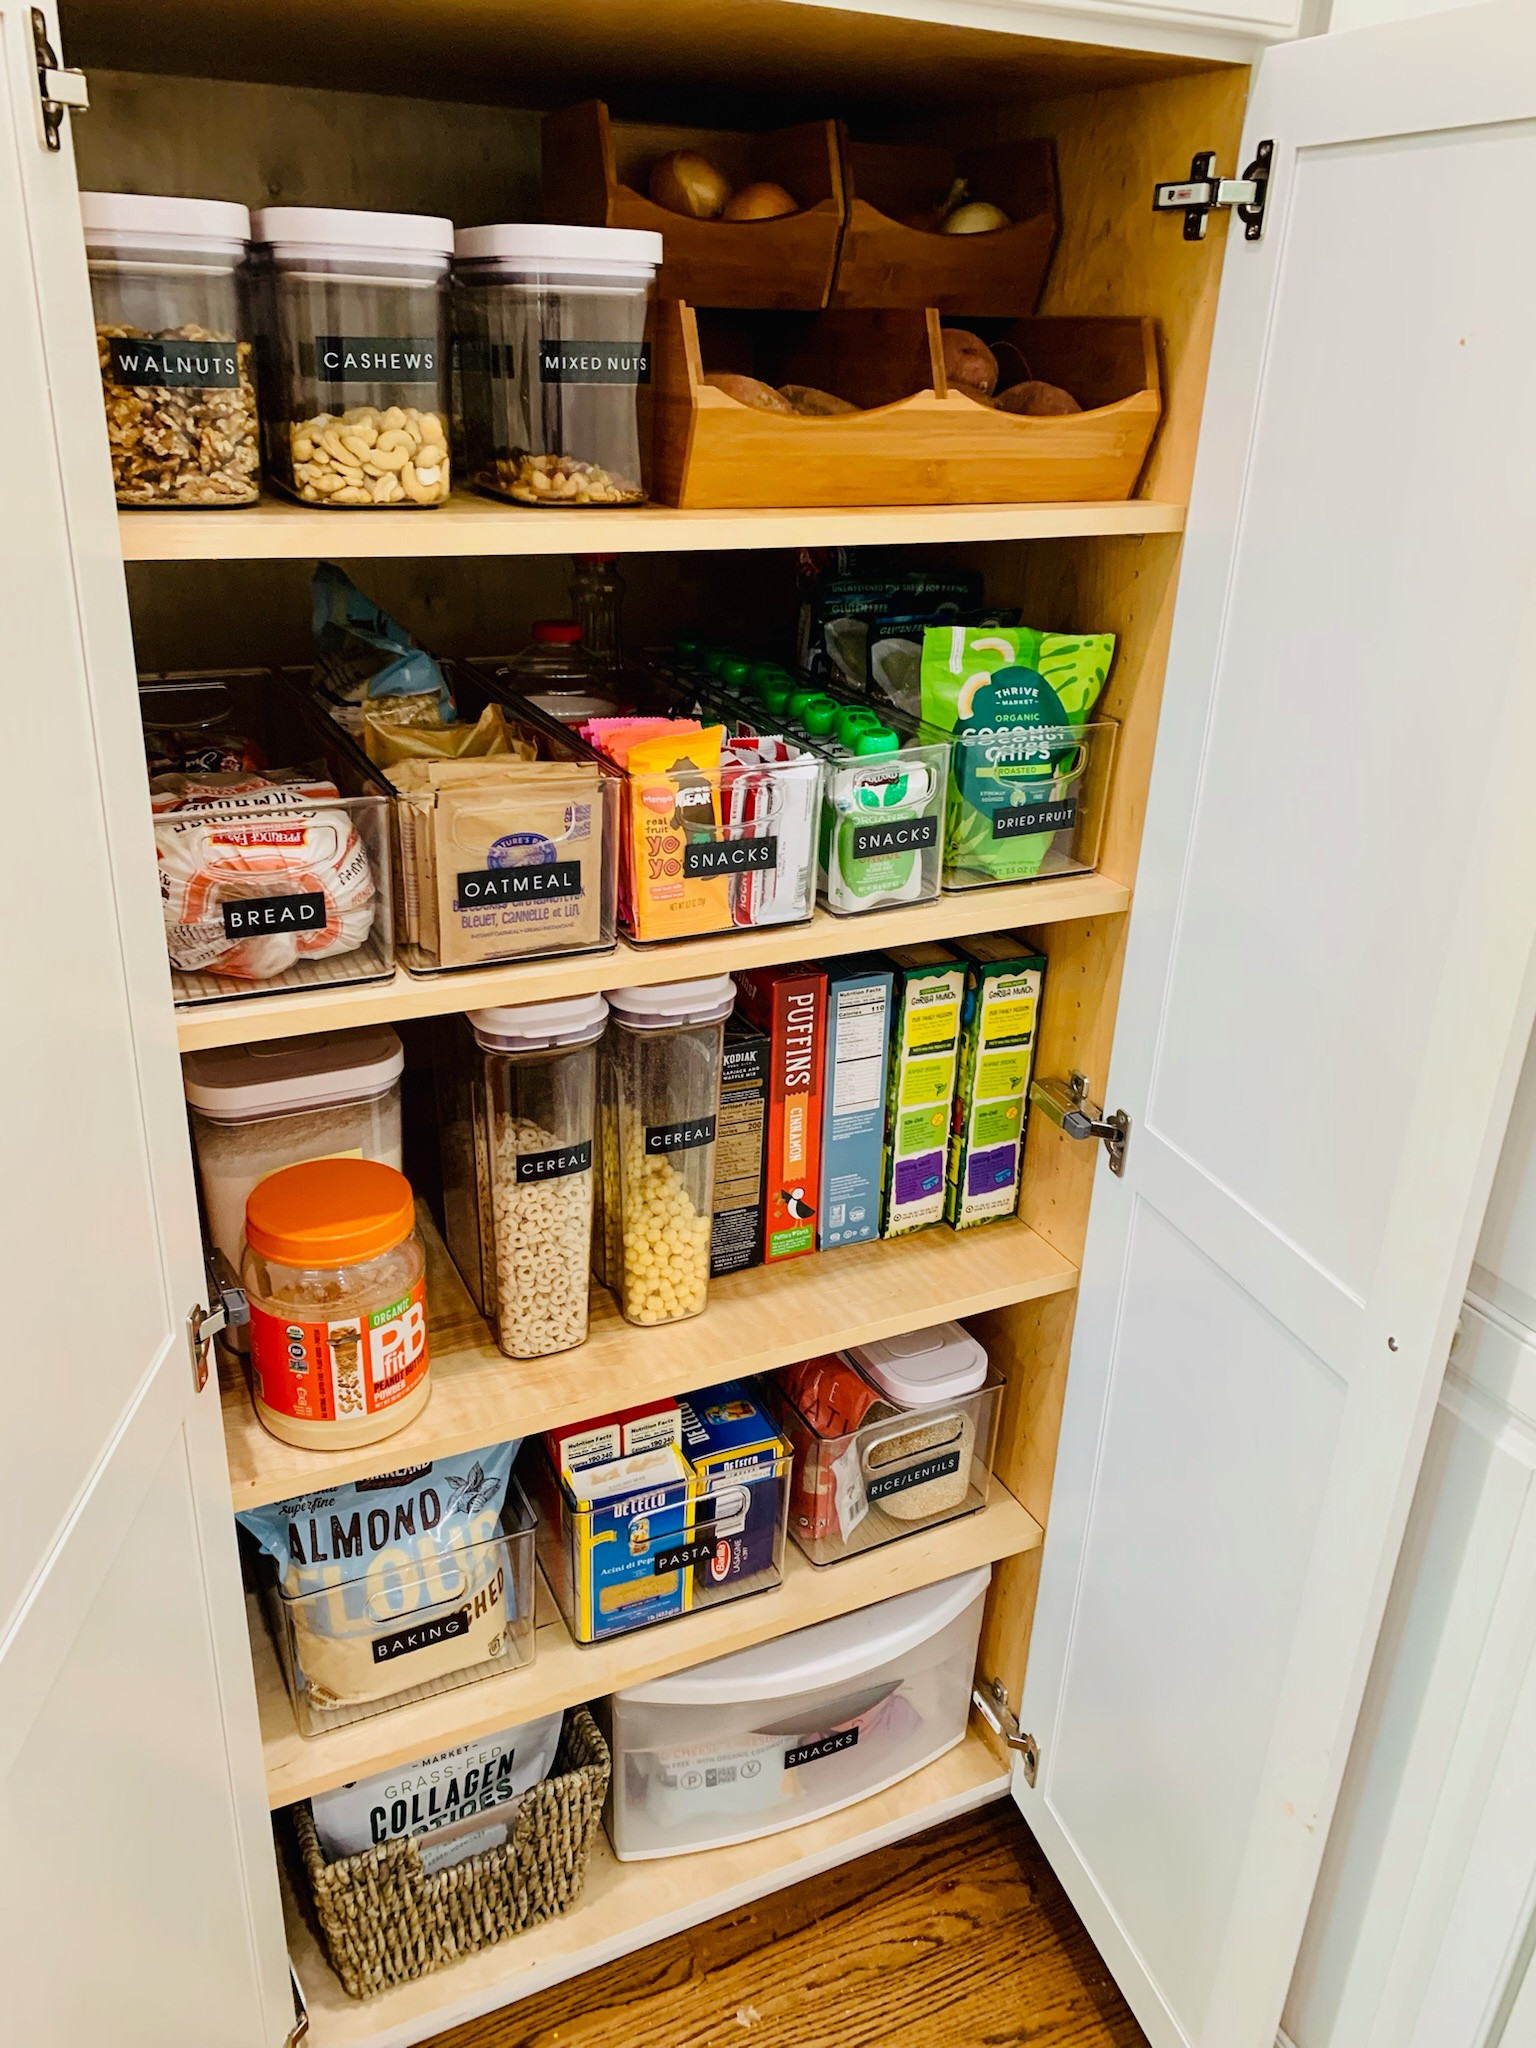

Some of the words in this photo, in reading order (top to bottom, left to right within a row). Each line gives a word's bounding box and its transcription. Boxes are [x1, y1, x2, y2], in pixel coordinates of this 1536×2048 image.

[118, 353, 237, 376] WALNUTS
[322, 351, 435, 371] CASHEWS
[545, 355, 602, 372] MIXED
[606, 355, 648, 373] NUTS
[994, 686, 1040, 699] THRIVE
[994, 713, 1040, 723] ORGANIC
[645, 826, 669, 835] fruit
[646, 817, 668, 826] real
[997, 813, 1036, 830] DRIED
[1038, 809, 1074, 825] FRUIT
[858, 826, 931, 850] SNACKS
[689, 846, 769, 870] SNACKS
[464, 873, 572, 898] OATMEAL
[230, 904, 316, 928] BREAD
[871, 1005, 885, 1013] 110
[784, 992, 815, 1087] PUFFINS
[723, 1050, 758, 1067] KODIAK
[649, 1126, 712, 1148] CEREAL
[747, 1121, 762, 1130] 200
[788, 1106, 804, 1164] CINNAMON
[521, 1153, 588, 1177] CEREAL
[374, 1297, 410, 1326] ORGANIC
[369, 1302, 426, 1384] PB
[383, 1350, 406, 1379] fit
[373, 1374, 405, 1394] PEANUT
[373, 1379, 406, 1402] POWDER
[631, 1424, 657, 1433] Nutrition
[657, 1418, 674, 1427] Facts
[568, 1438, 594, 1449] Nutrition
[595, 1433, 612, 1442] Facts
[870, 1458, 956, 1496] RICE/LENTILS
[278, 1496, 338, 1519] Superfine
[288, 1487, 442, 1566] ALMOND
[659, 1546, 711, 1569] PASTA
[715, 1544, 726, 1572] Barilla
[733, 1539, 742, 1574] LASAGNE
[288, 1510, 501, 1637] FLOUR
[600, 1563, 625, 1576] Acini
[625, 1561, 636, 1570] di
[377, 1620, 461, 1657] BAKING
[421, 1745, 471, 1768] MARKET
[787, 1733, 854, 1765] SNACKS
[384, 1746, 503, 1800] GRASS-FED
[369, 1747, 516, 1846] COLLAGEN
